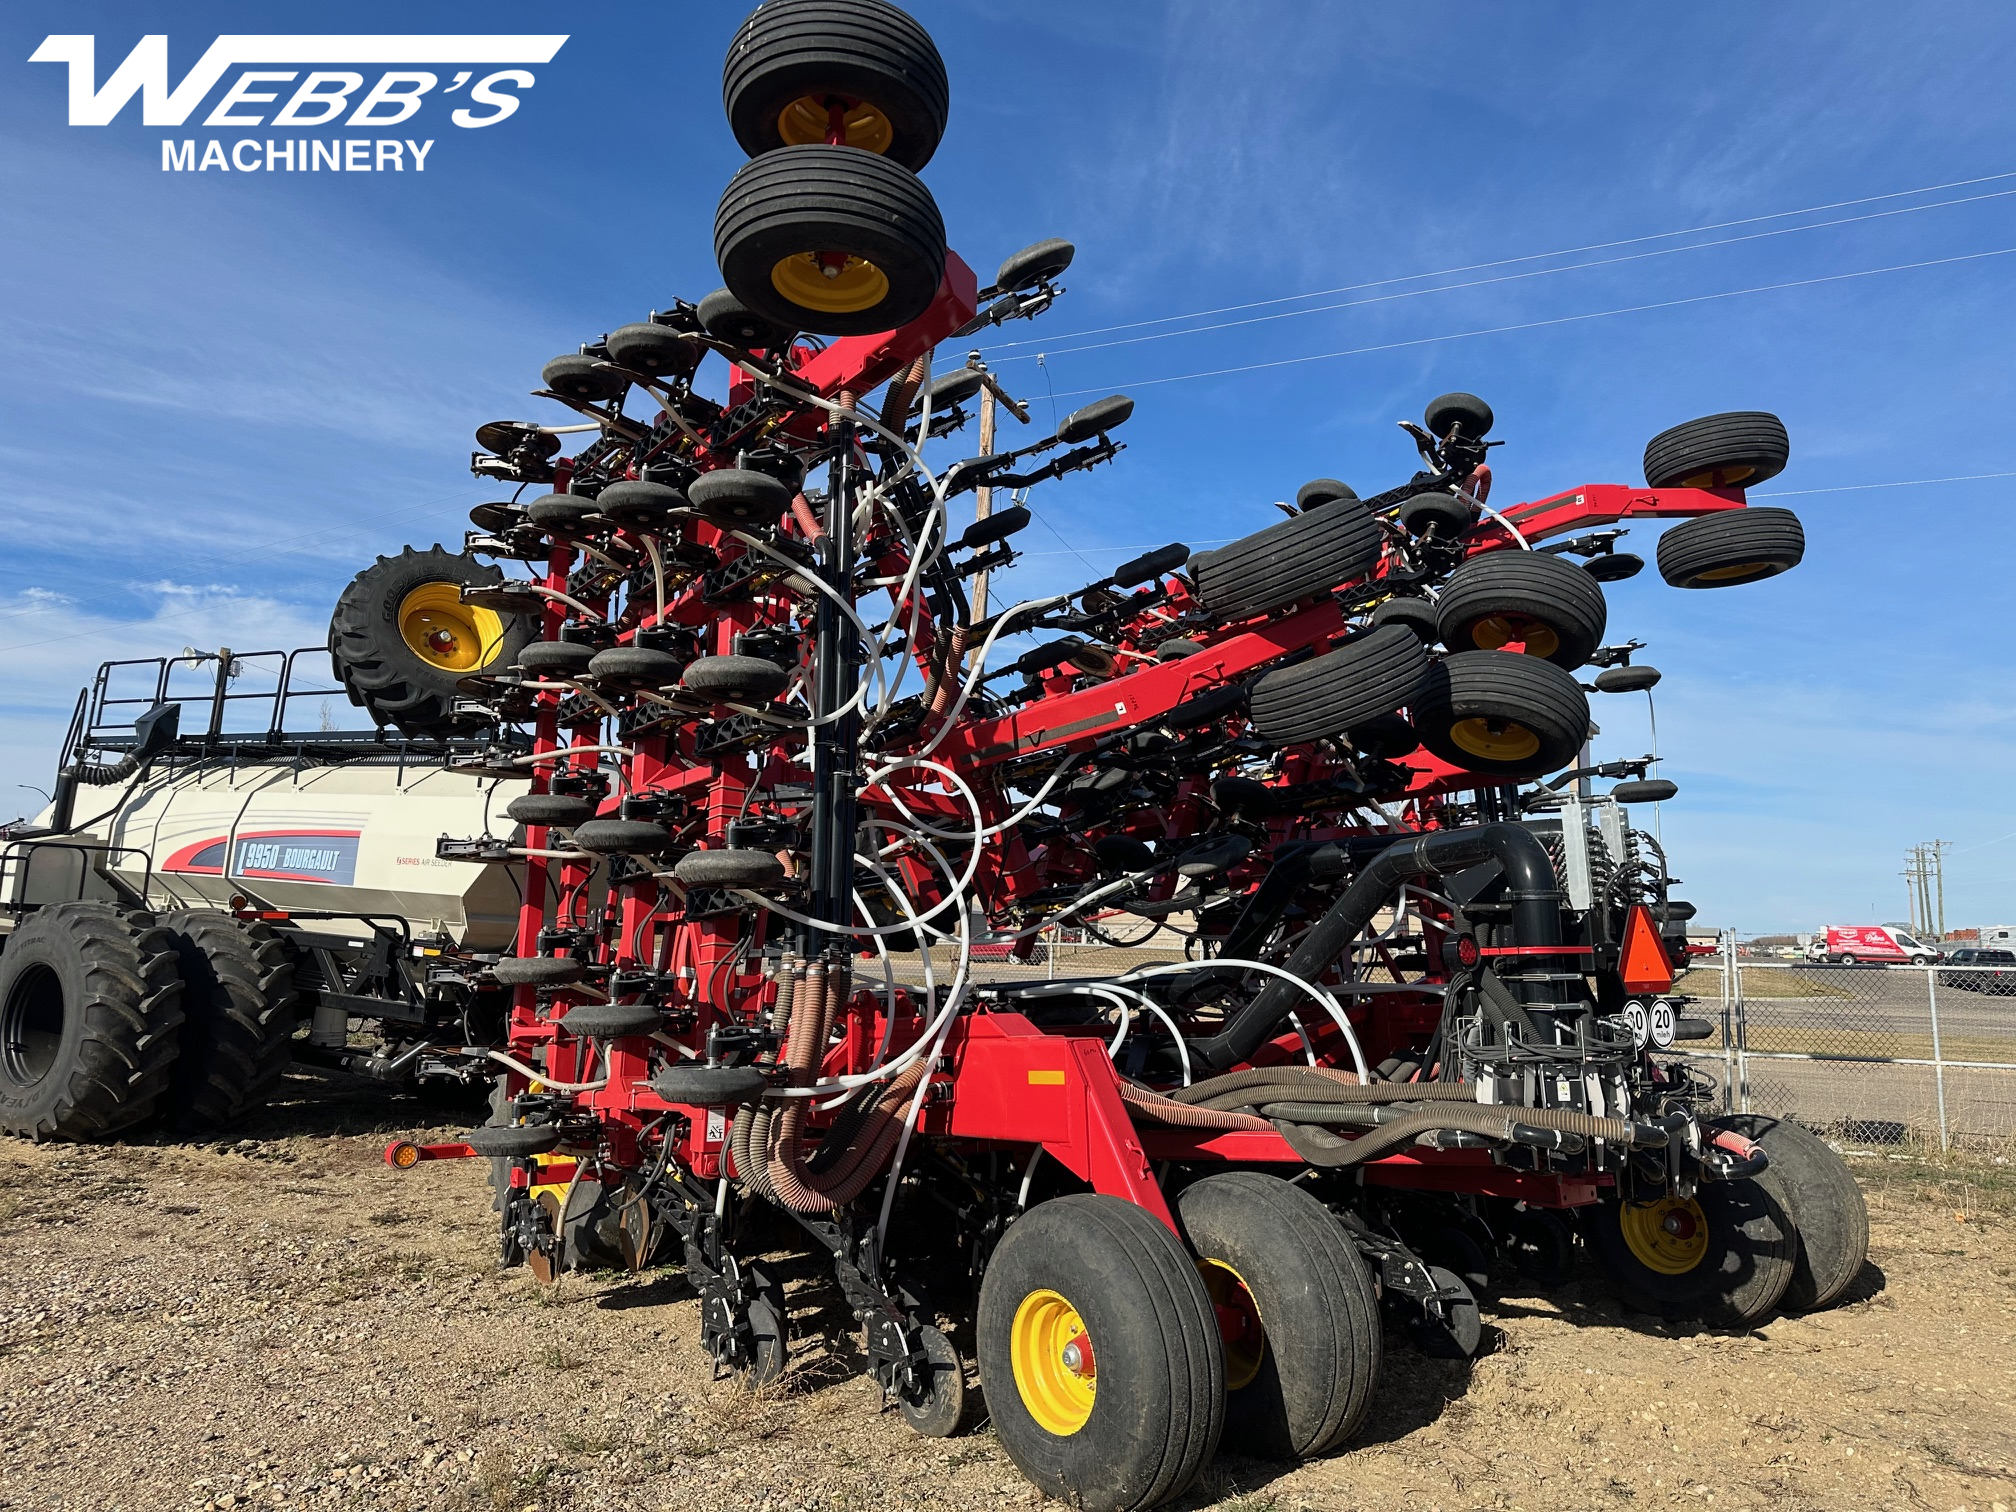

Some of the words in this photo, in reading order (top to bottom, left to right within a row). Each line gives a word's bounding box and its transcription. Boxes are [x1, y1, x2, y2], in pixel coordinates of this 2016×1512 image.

[245, 843, 280, 870] 9950
[282, 848, 340, 871] BOURGAULT
[402, 857, 420, 865] SERIES
[421, 858, 430, 866] AIR
[1655, 1009, 1670, 1029] 20
